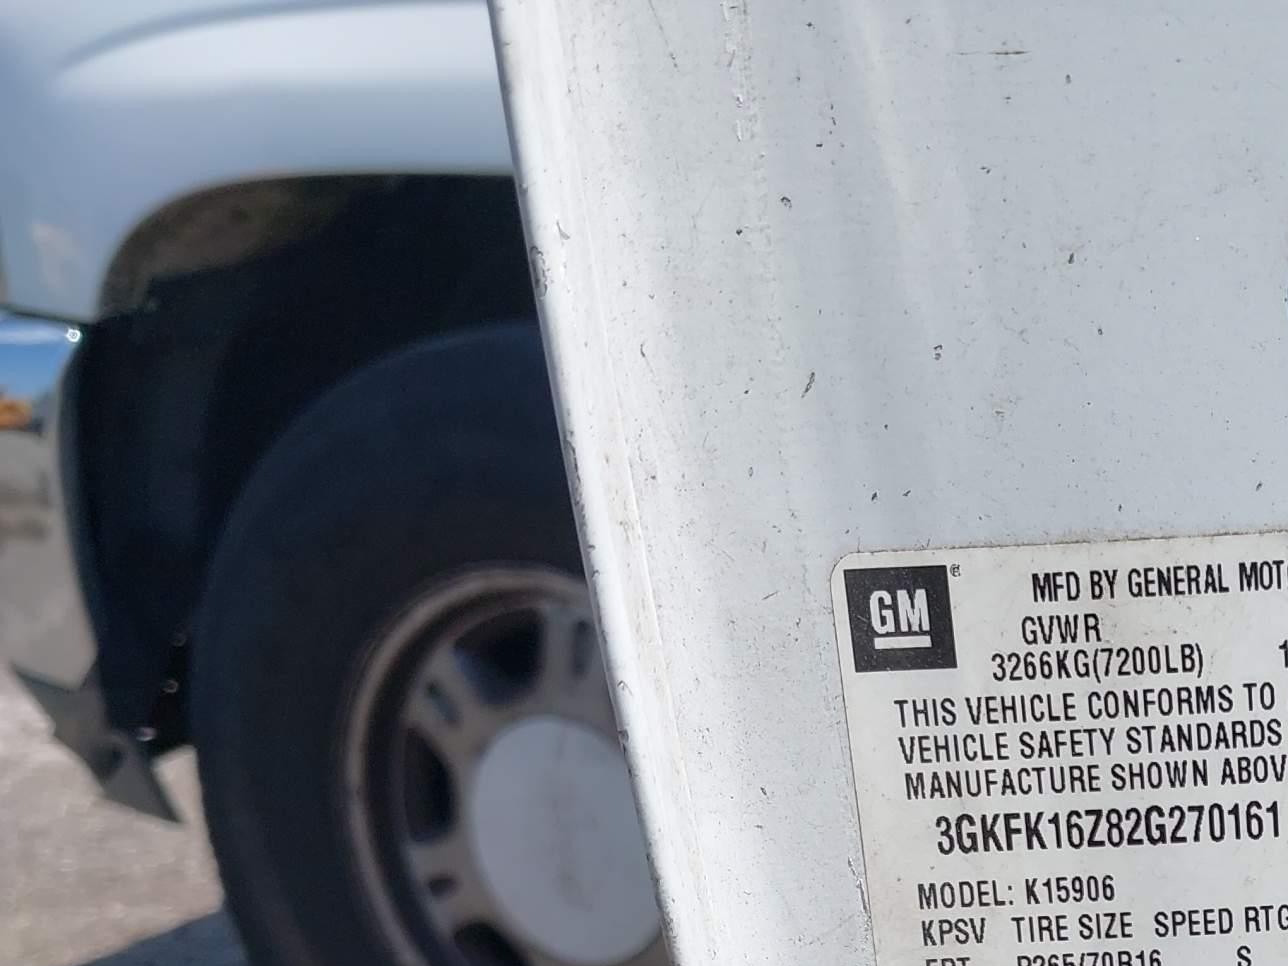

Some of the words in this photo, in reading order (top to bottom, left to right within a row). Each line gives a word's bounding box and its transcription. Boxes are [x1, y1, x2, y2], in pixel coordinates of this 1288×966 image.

[1032, 571, 1080, 602] MFD
[1090, 569, 1118, 600] BY
[1128, 564, 1229, 598] GENERAL
[870, 589, 930, 634] GM
[1022, 613, 1102, 645] GVWR
[992, 643, 1203, 684] 3266KG(7200LB)
[894, 698, 956, 728] THIS
[965, 693, 1076, 725] VEHICLE
[1088, 684, 1233, 720] CONFORMS
[1243, 682, 1275, 711] TO
[898, 732, 1009, 764] VEHICLE
[1019, 727, 1115, 759] SAFETY
[1126, 718, 1282, 754] STANDARDS
[905, 764, 1101, 800] MANUFACTURE
[1111, 759, 1208, 791] SHOWN
[936, 801, 1279, 855] 3GKFK16Z82G270161
[918, 880, 1013, 910] MODEL:
[1025, 875, 1114, 904] K15906
[922, 917, 986, 946] KPSV
[1011, 915, 1069, 943] TIRE
[1078, 912, 1133, 940] SIZE
[1154, 908, 1233, 937] SPEED
